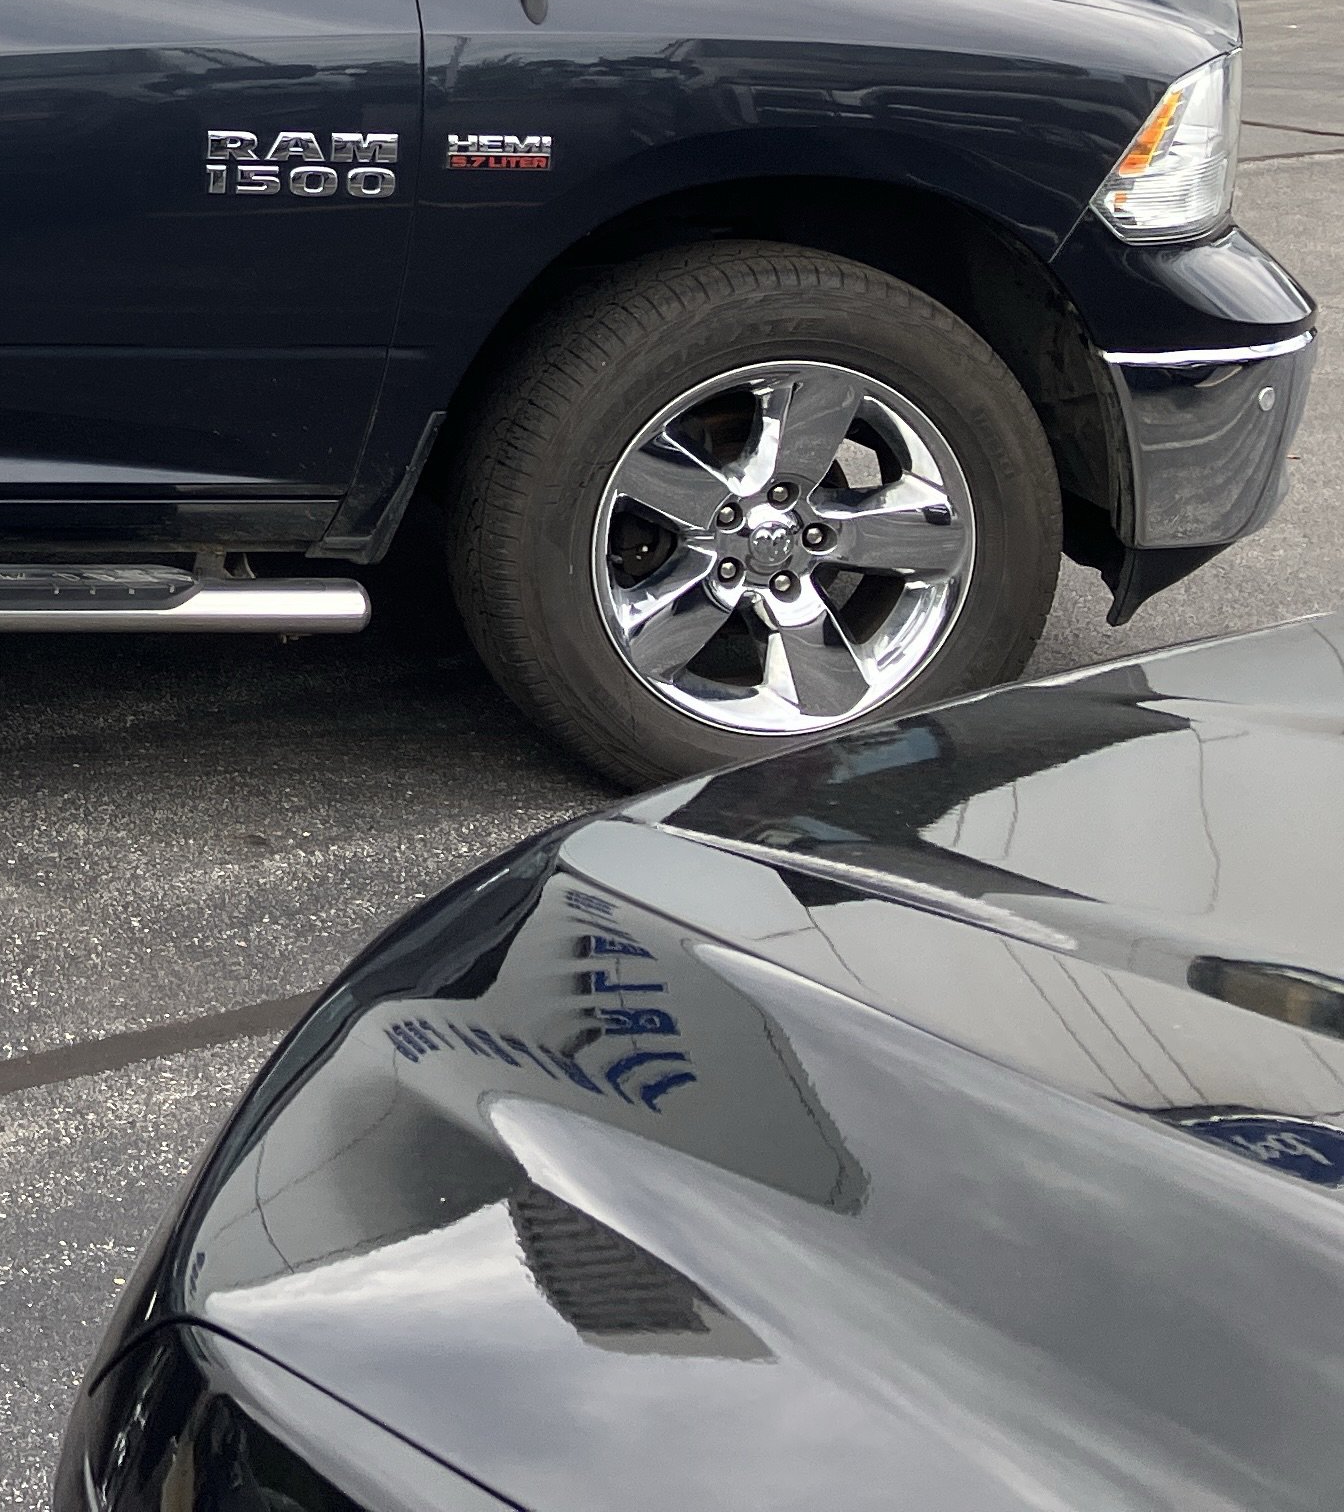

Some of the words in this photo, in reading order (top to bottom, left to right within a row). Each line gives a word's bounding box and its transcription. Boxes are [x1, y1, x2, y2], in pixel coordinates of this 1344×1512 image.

[207, 130, 400, 164] RAM
[448, 135, 552, 154] HEMI
[449, 156, 484, 168] 5.7
[488, 156, 549, 168] LITER
[206, 165, 397, 198] 1500
